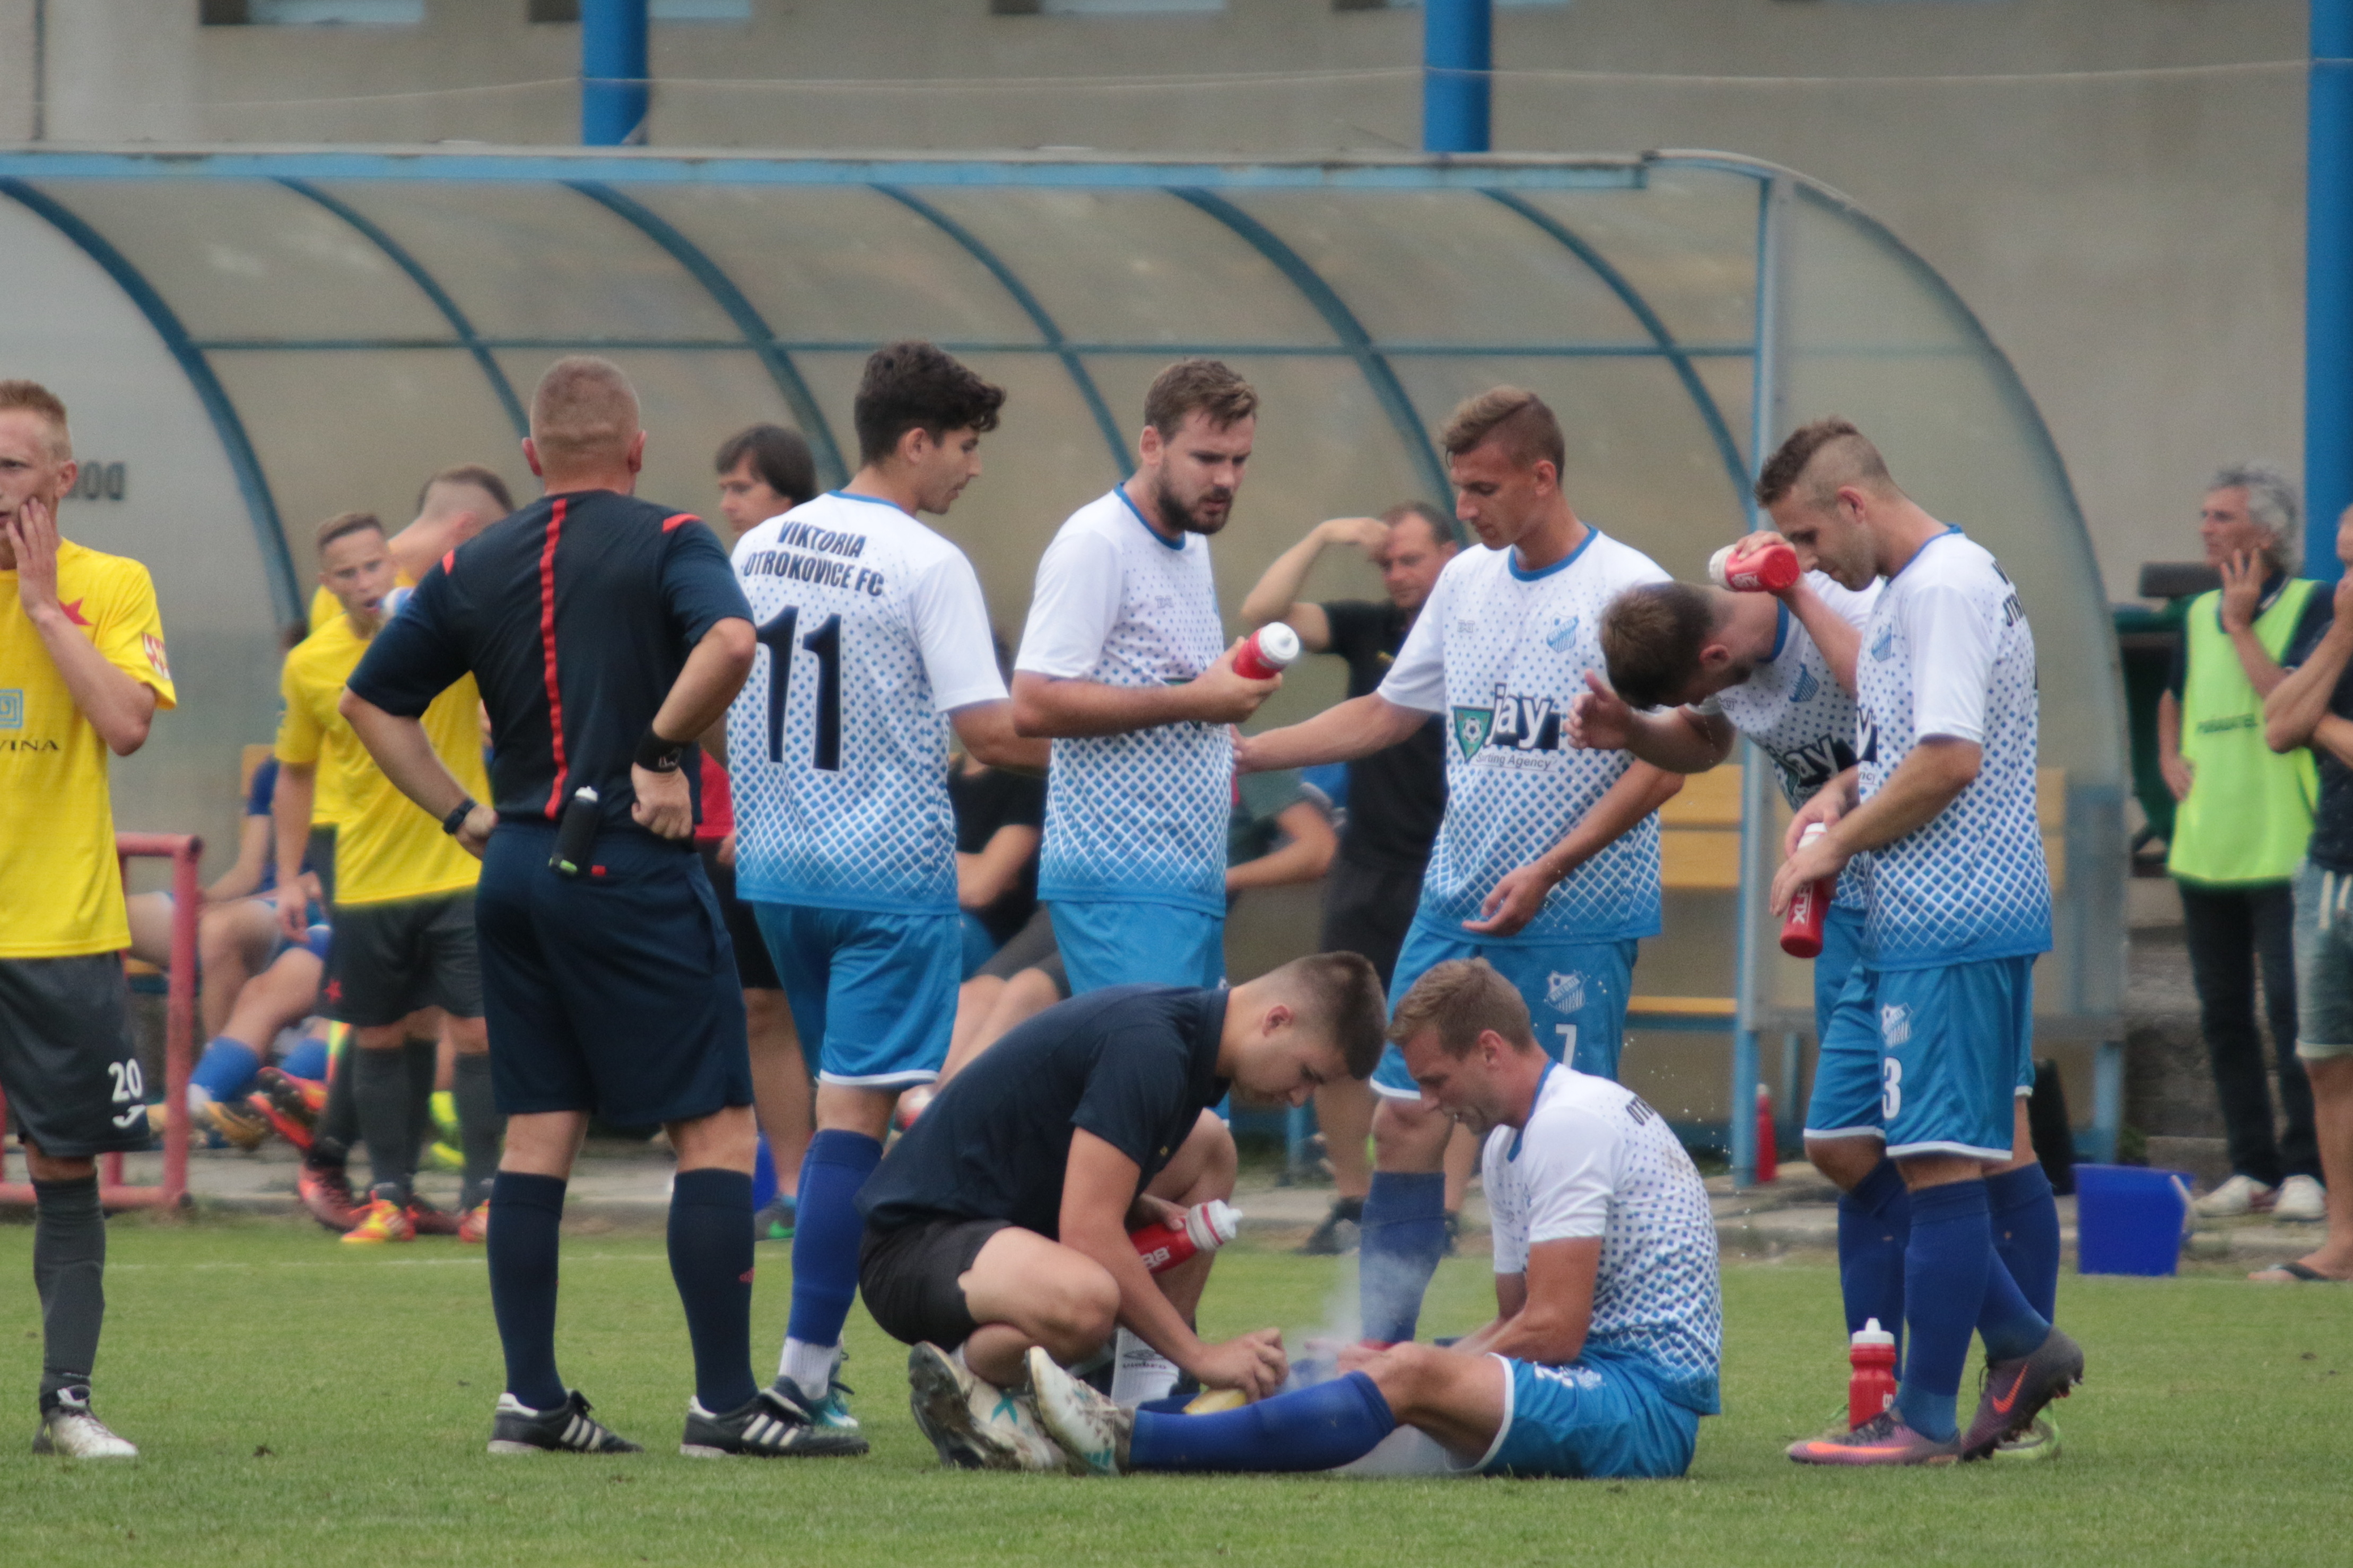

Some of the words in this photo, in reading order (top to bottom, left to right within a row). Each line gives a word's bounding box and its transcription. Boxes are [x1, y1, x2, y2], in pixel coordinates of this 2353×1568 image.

[778, 521, 867, 558] VIKTORIA
[744, 550, 855, 588] OTROKOVICE
[855, 567, 885, 596] FC
[755, 605, 842, 772] 11
[1484, 682, 1555, 751] jay
[1508, 755, 1551, 771] Agency
[1556, 1023, 1577, 1069] 7
[108, 1058, 143, 1102] 20
